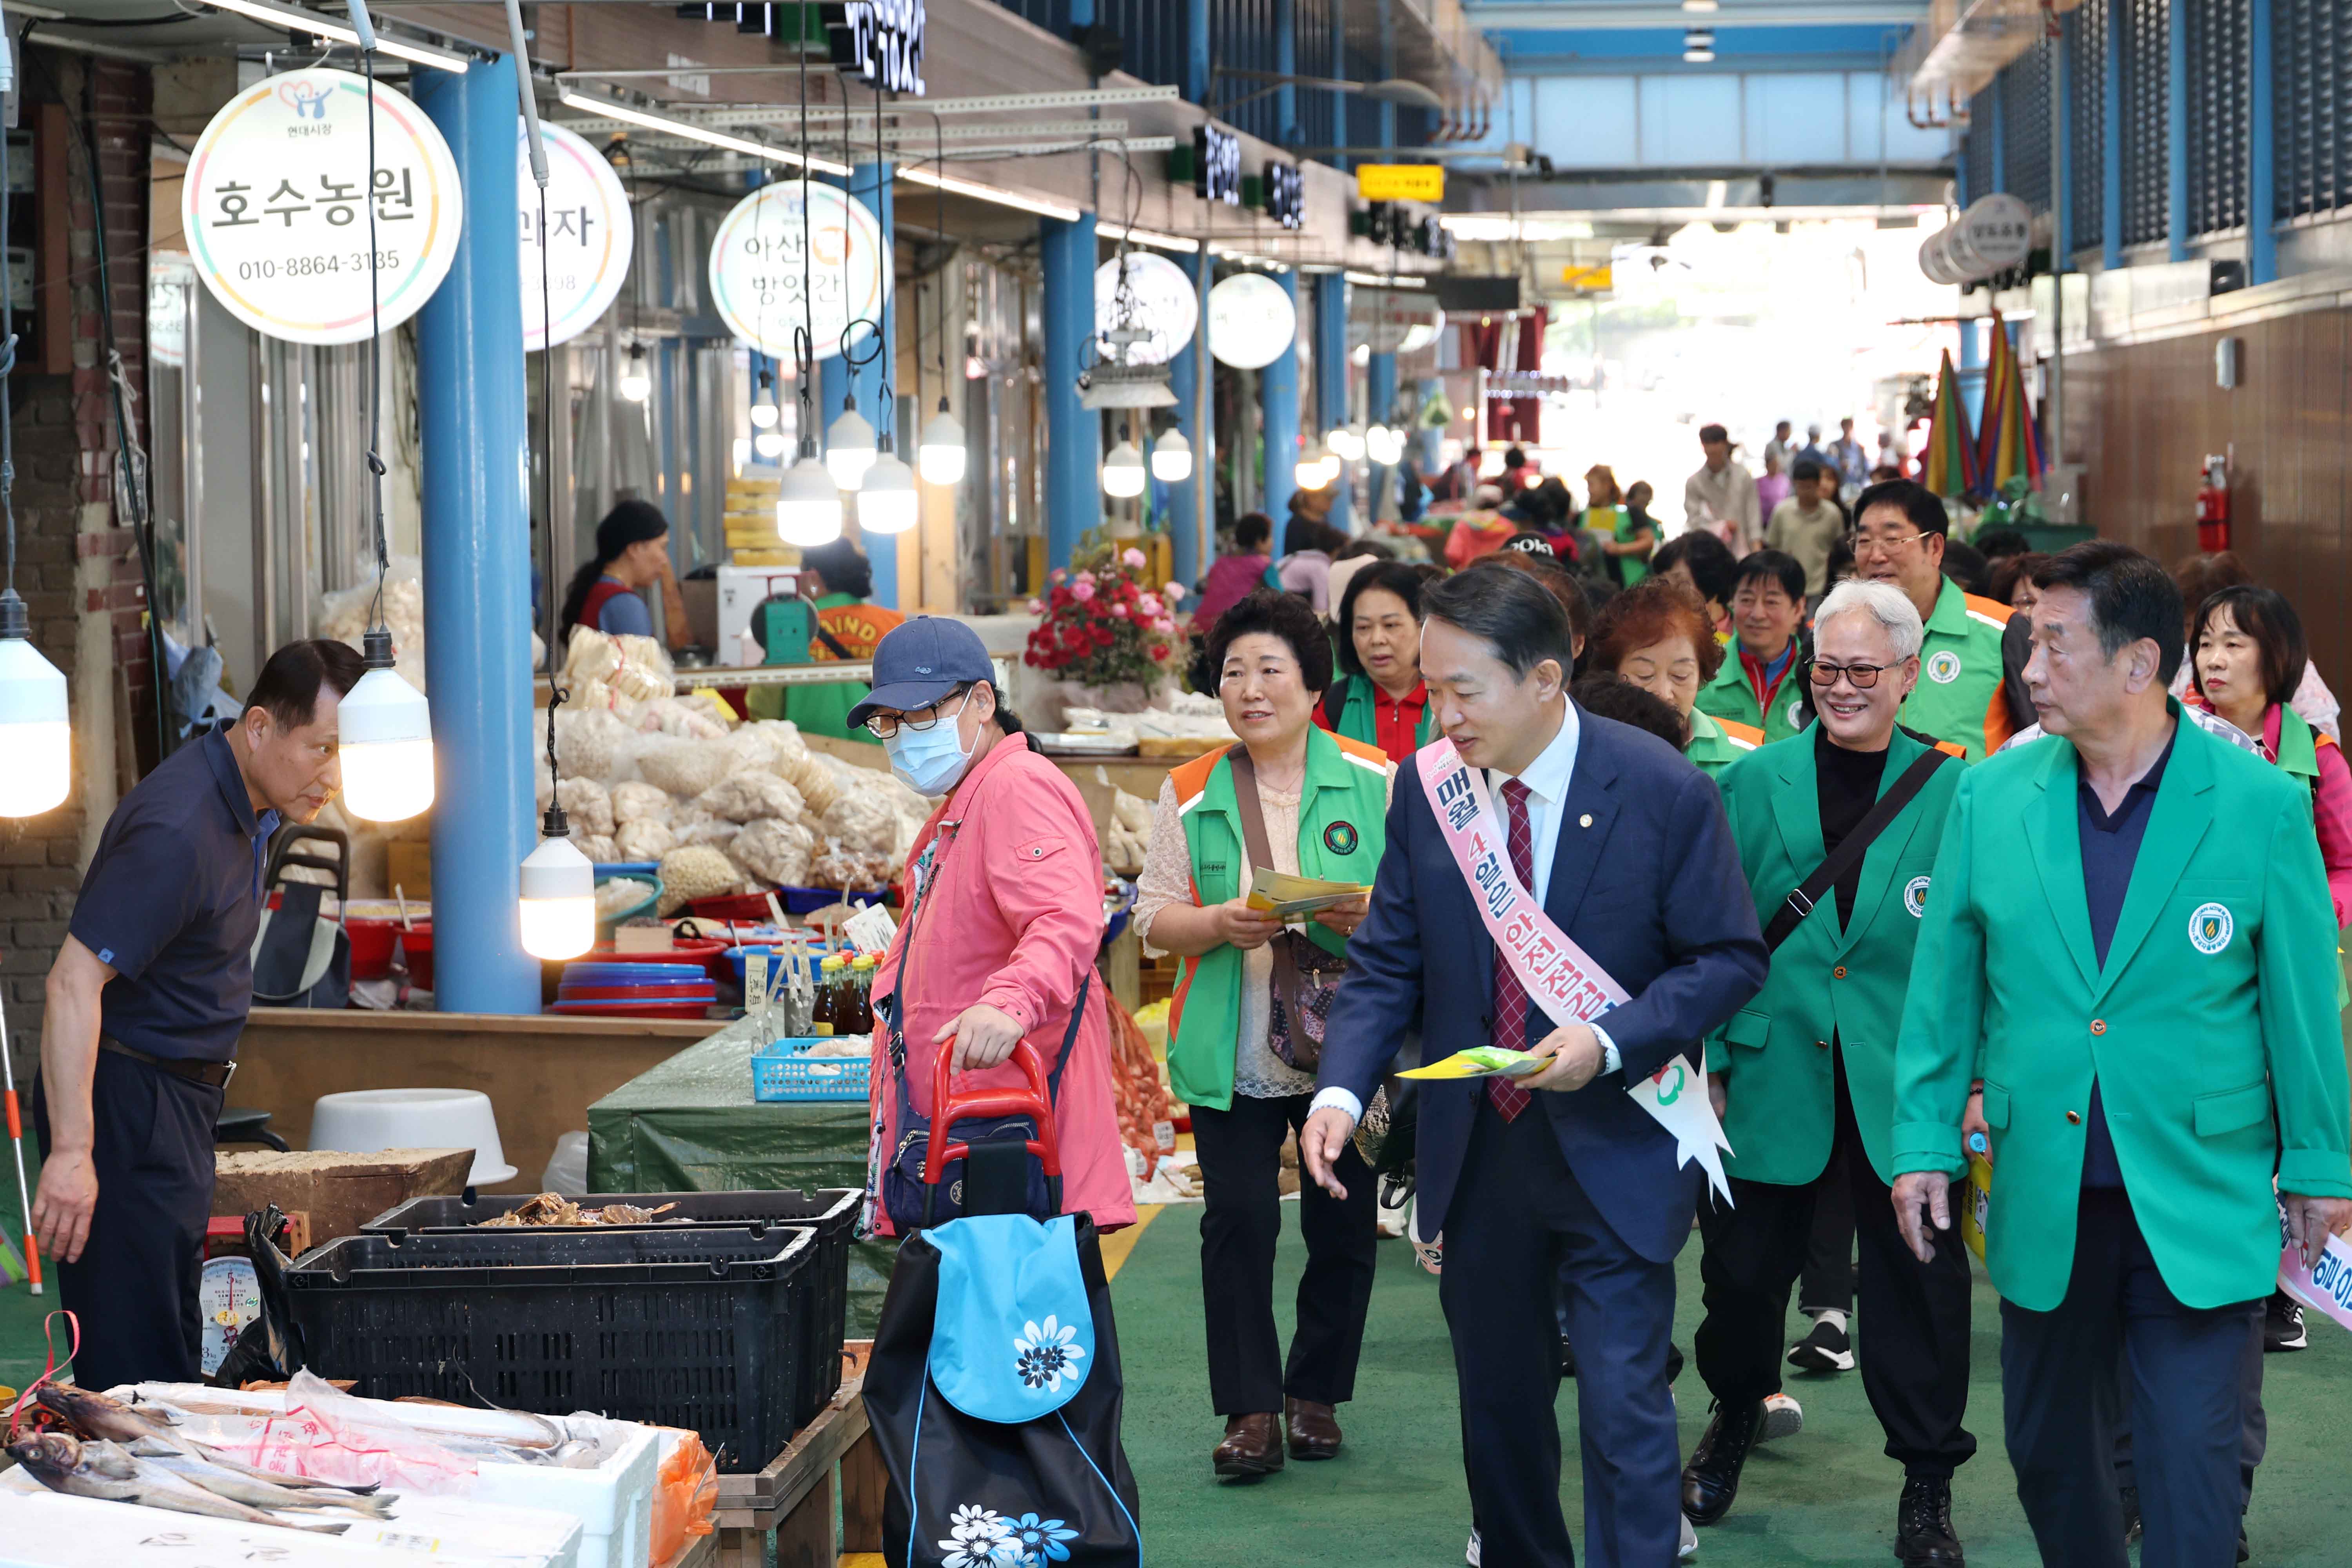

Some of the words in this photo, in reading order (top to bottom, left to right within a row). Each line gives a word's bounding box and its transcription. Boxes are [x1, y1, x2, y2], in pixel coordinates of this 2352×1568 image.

[287, 124, 332, 137] 현대시장
[212, 168, 414, 227] 호수농원
[745, 234, 806, 263] 아산
[752, 274, 842, 305] 방앗간
[1436, 766, 1481, 831] 매월
[1470, 831, 1516, 919] 4일은
[1505, 912, 1616, 1022] 안전점검
